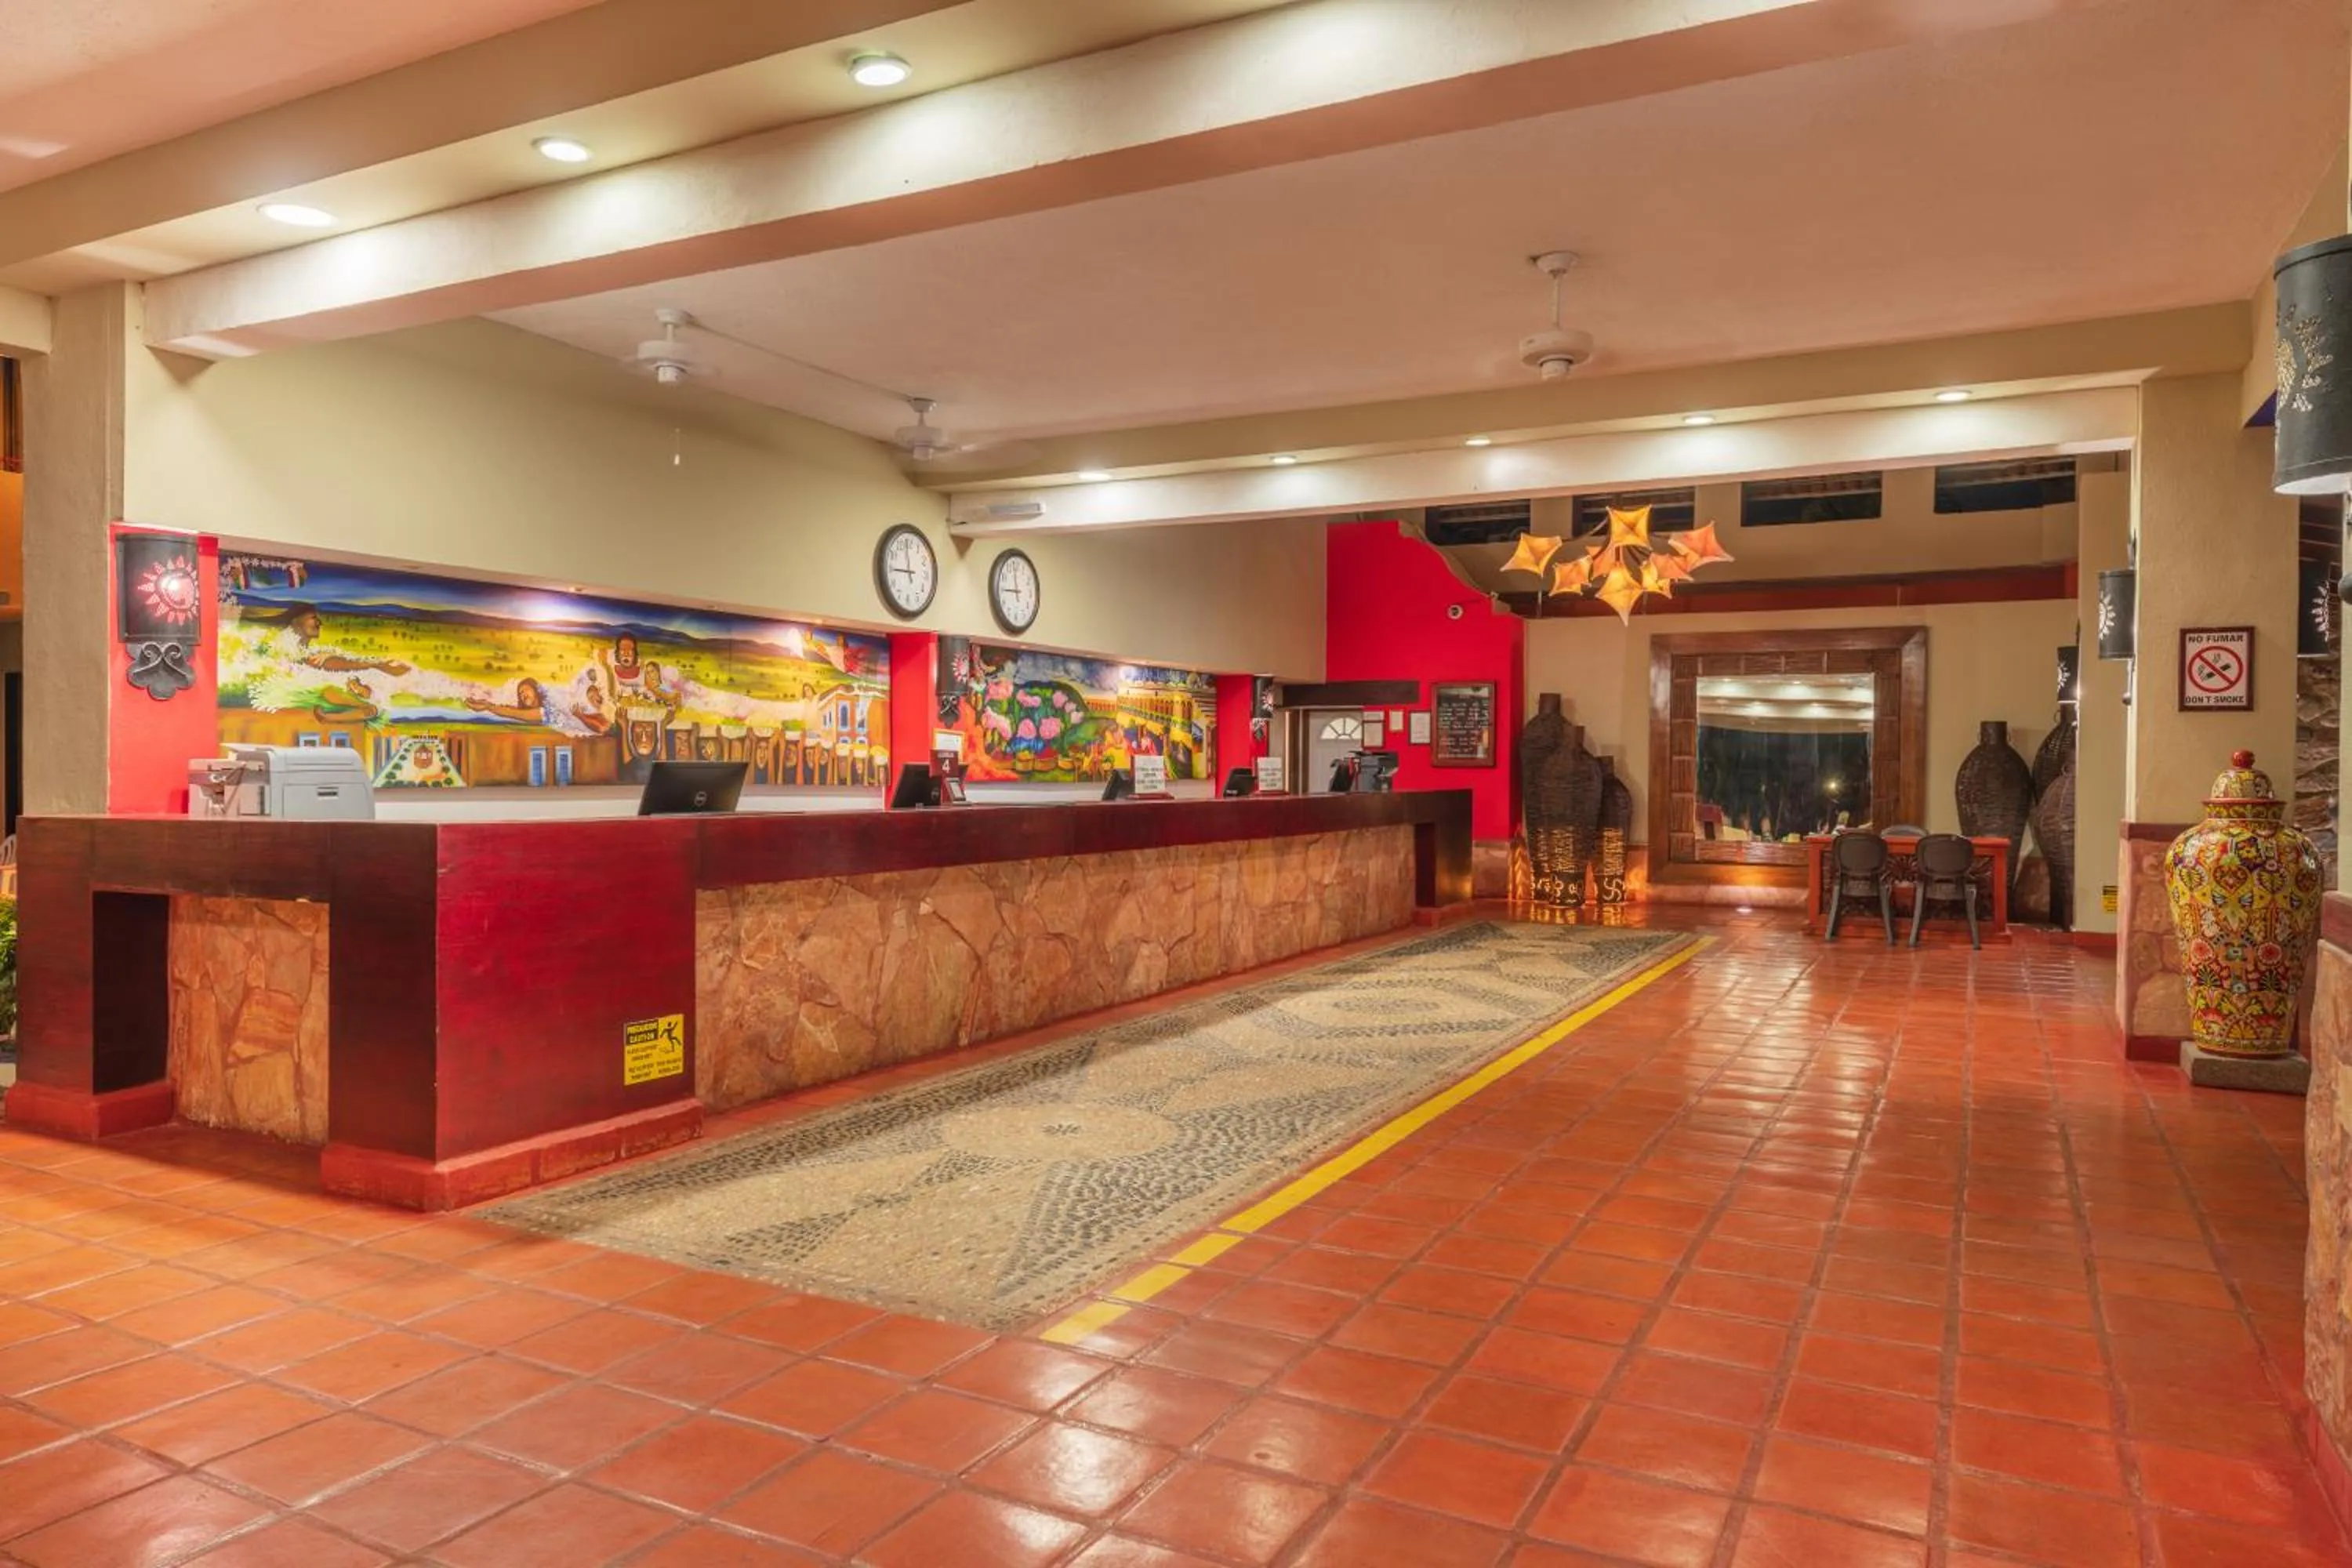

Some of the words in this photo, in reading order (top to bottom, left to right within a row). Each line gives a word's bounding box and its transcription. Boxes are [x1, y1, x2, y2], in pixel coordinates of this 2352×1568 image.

[2206, 634, 2243, 643] FUMAR
[2185, 695, 2212, 704] DONT
[942, 758, 951, 774] 4
